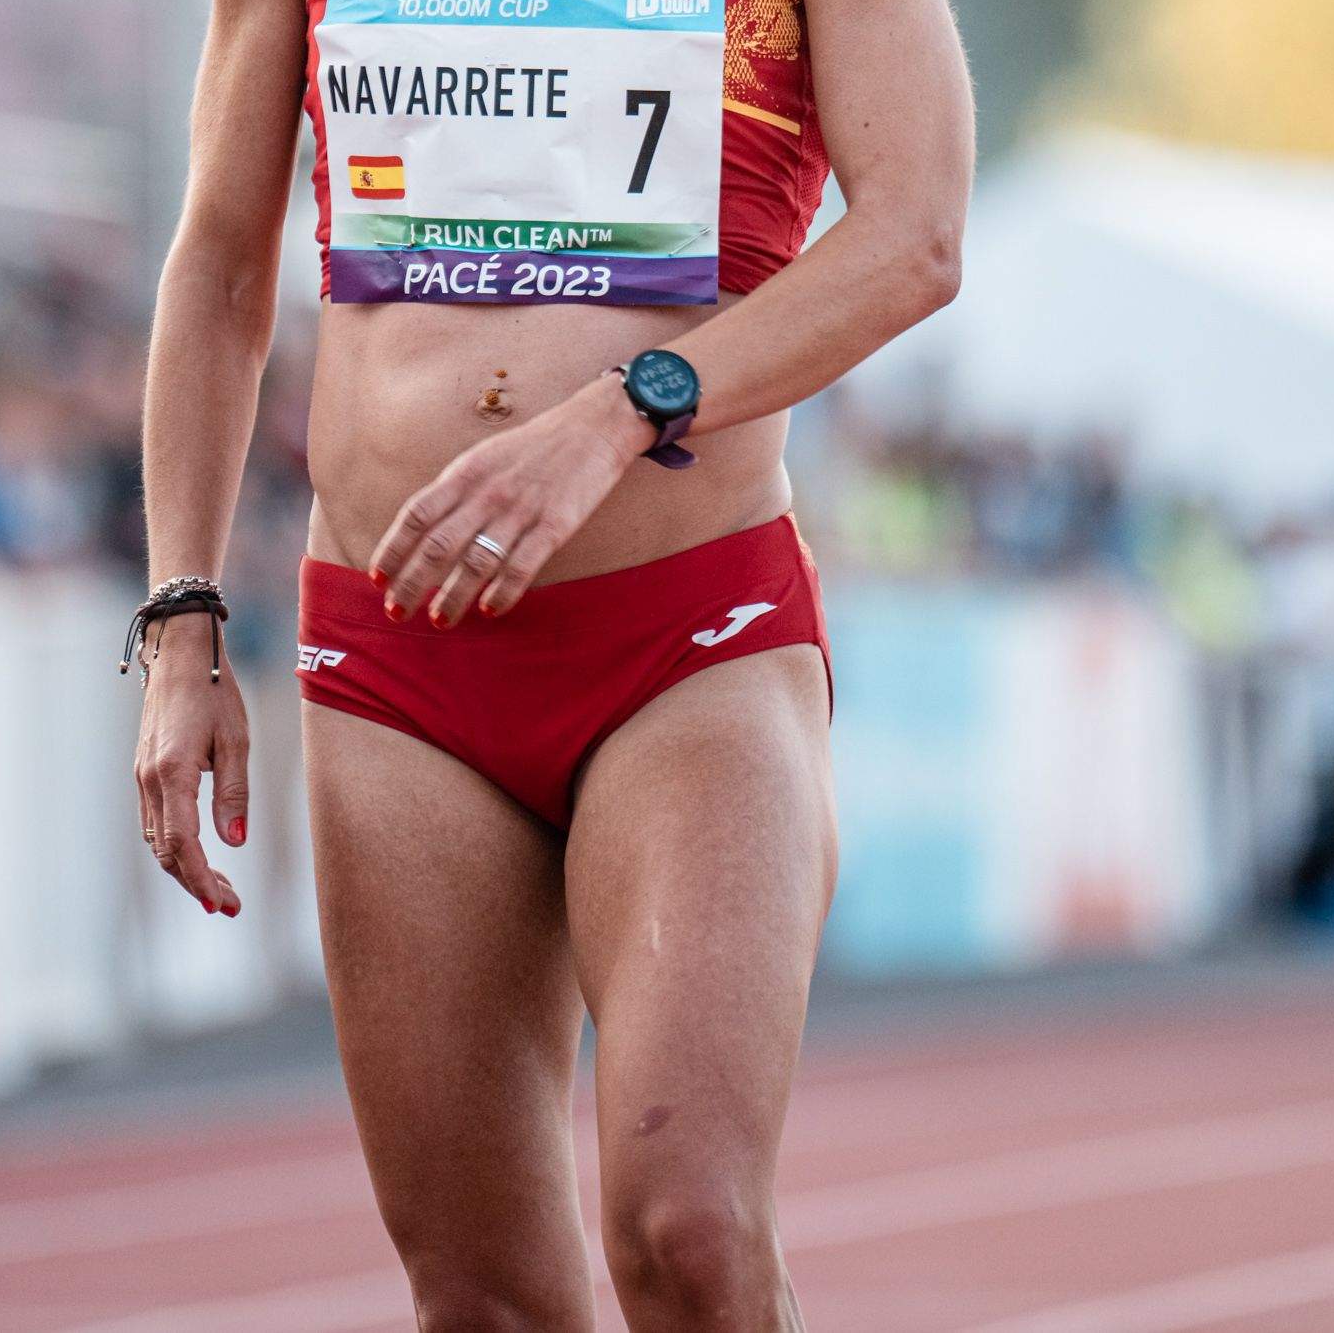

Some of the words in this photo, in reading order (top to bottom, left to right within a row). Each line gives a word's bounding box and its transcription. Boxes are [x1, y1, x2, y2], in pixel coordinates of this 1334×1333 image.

[327, 64, 568, 118] NAVARRETE
[625, 89, 671, 194] 7
[424, 224, 485, 247] RUN
[404, 253, 502, 295] PACÉ
[510, 264, 611, 297] 2023
[297, 643, 347, 672] SP
